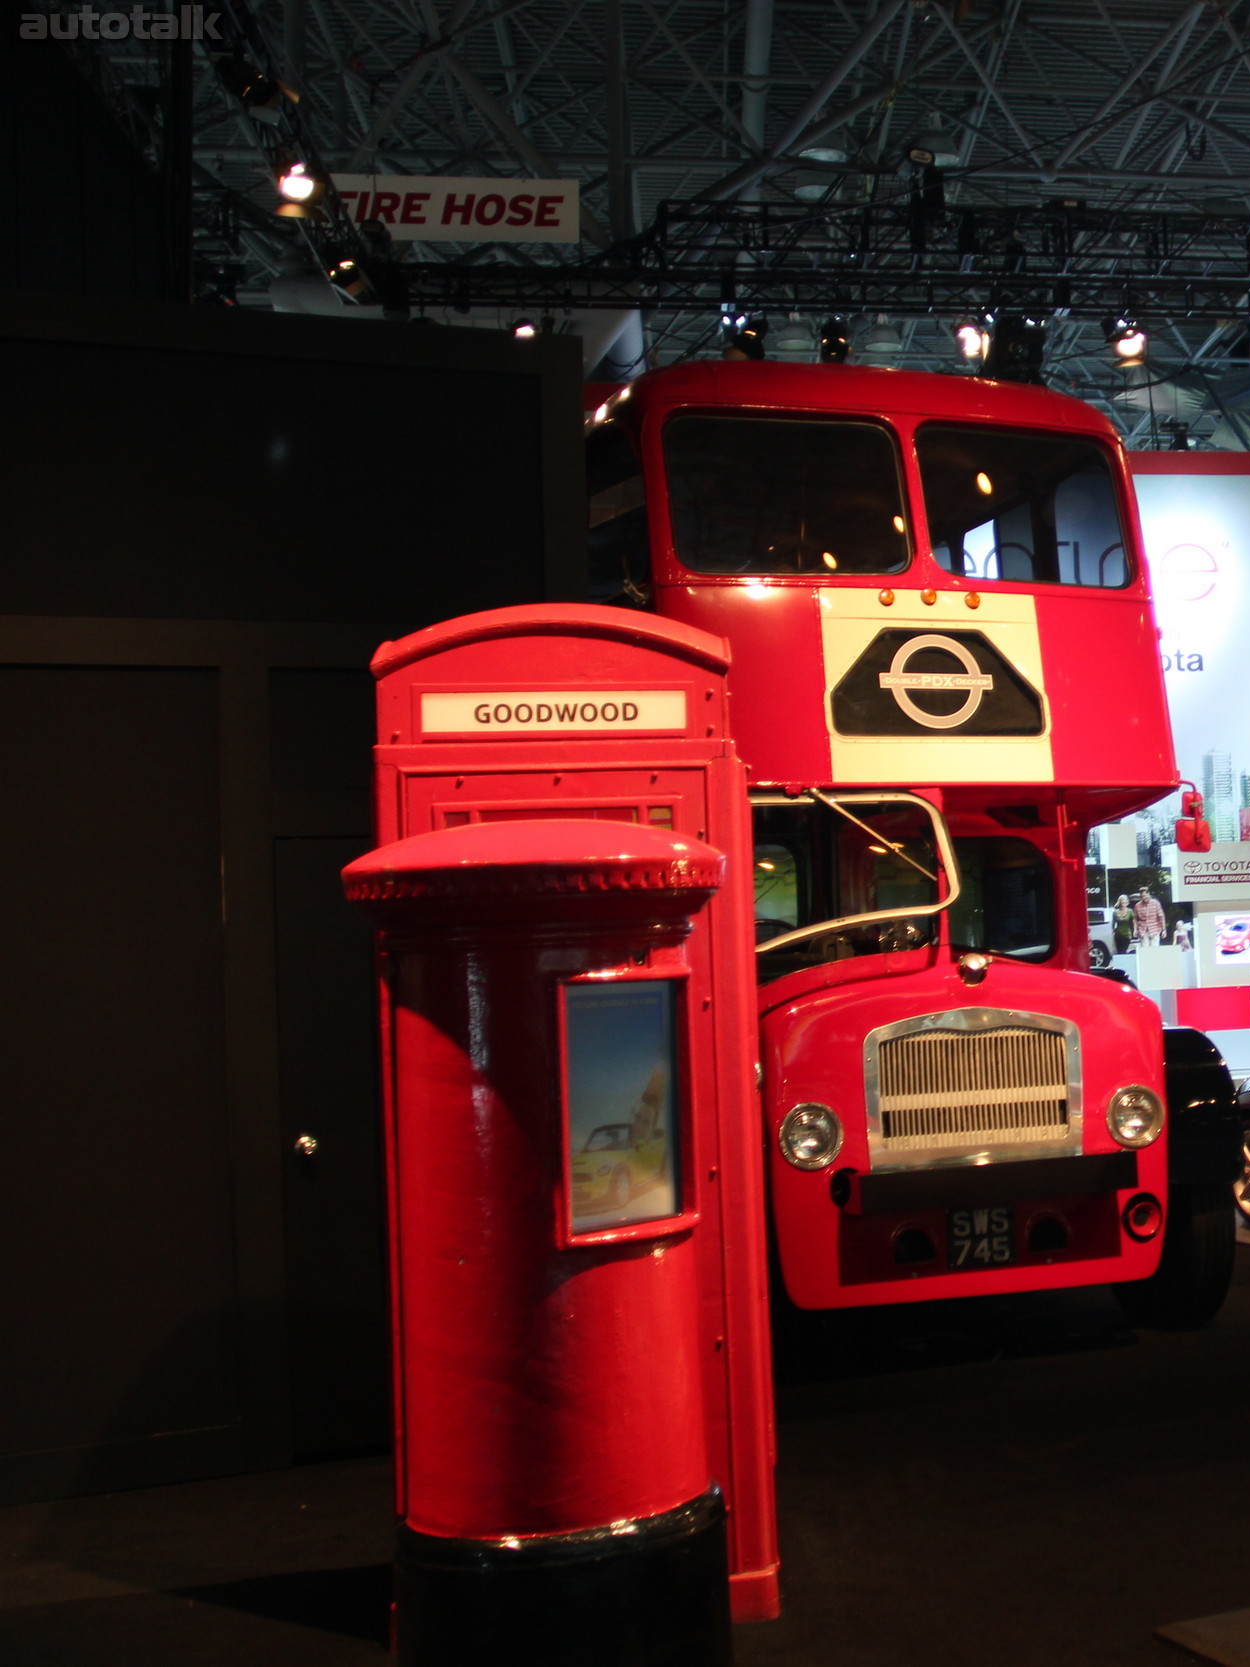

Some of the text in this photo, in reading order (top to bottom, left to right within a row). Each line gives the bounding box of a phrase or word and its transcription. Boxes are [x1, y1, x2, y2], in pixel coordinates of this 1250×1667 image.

[441, 193, 564, 228] HOSE
[921, 675, 953, 687] PDX
[474, 702, 639, 724] GOODWOOD
[1186, 875, 1219, 884] FINANCIAL
[953, 1208, 1009, 1237] SWS
[953, 1236, 1011, 1266] 745
